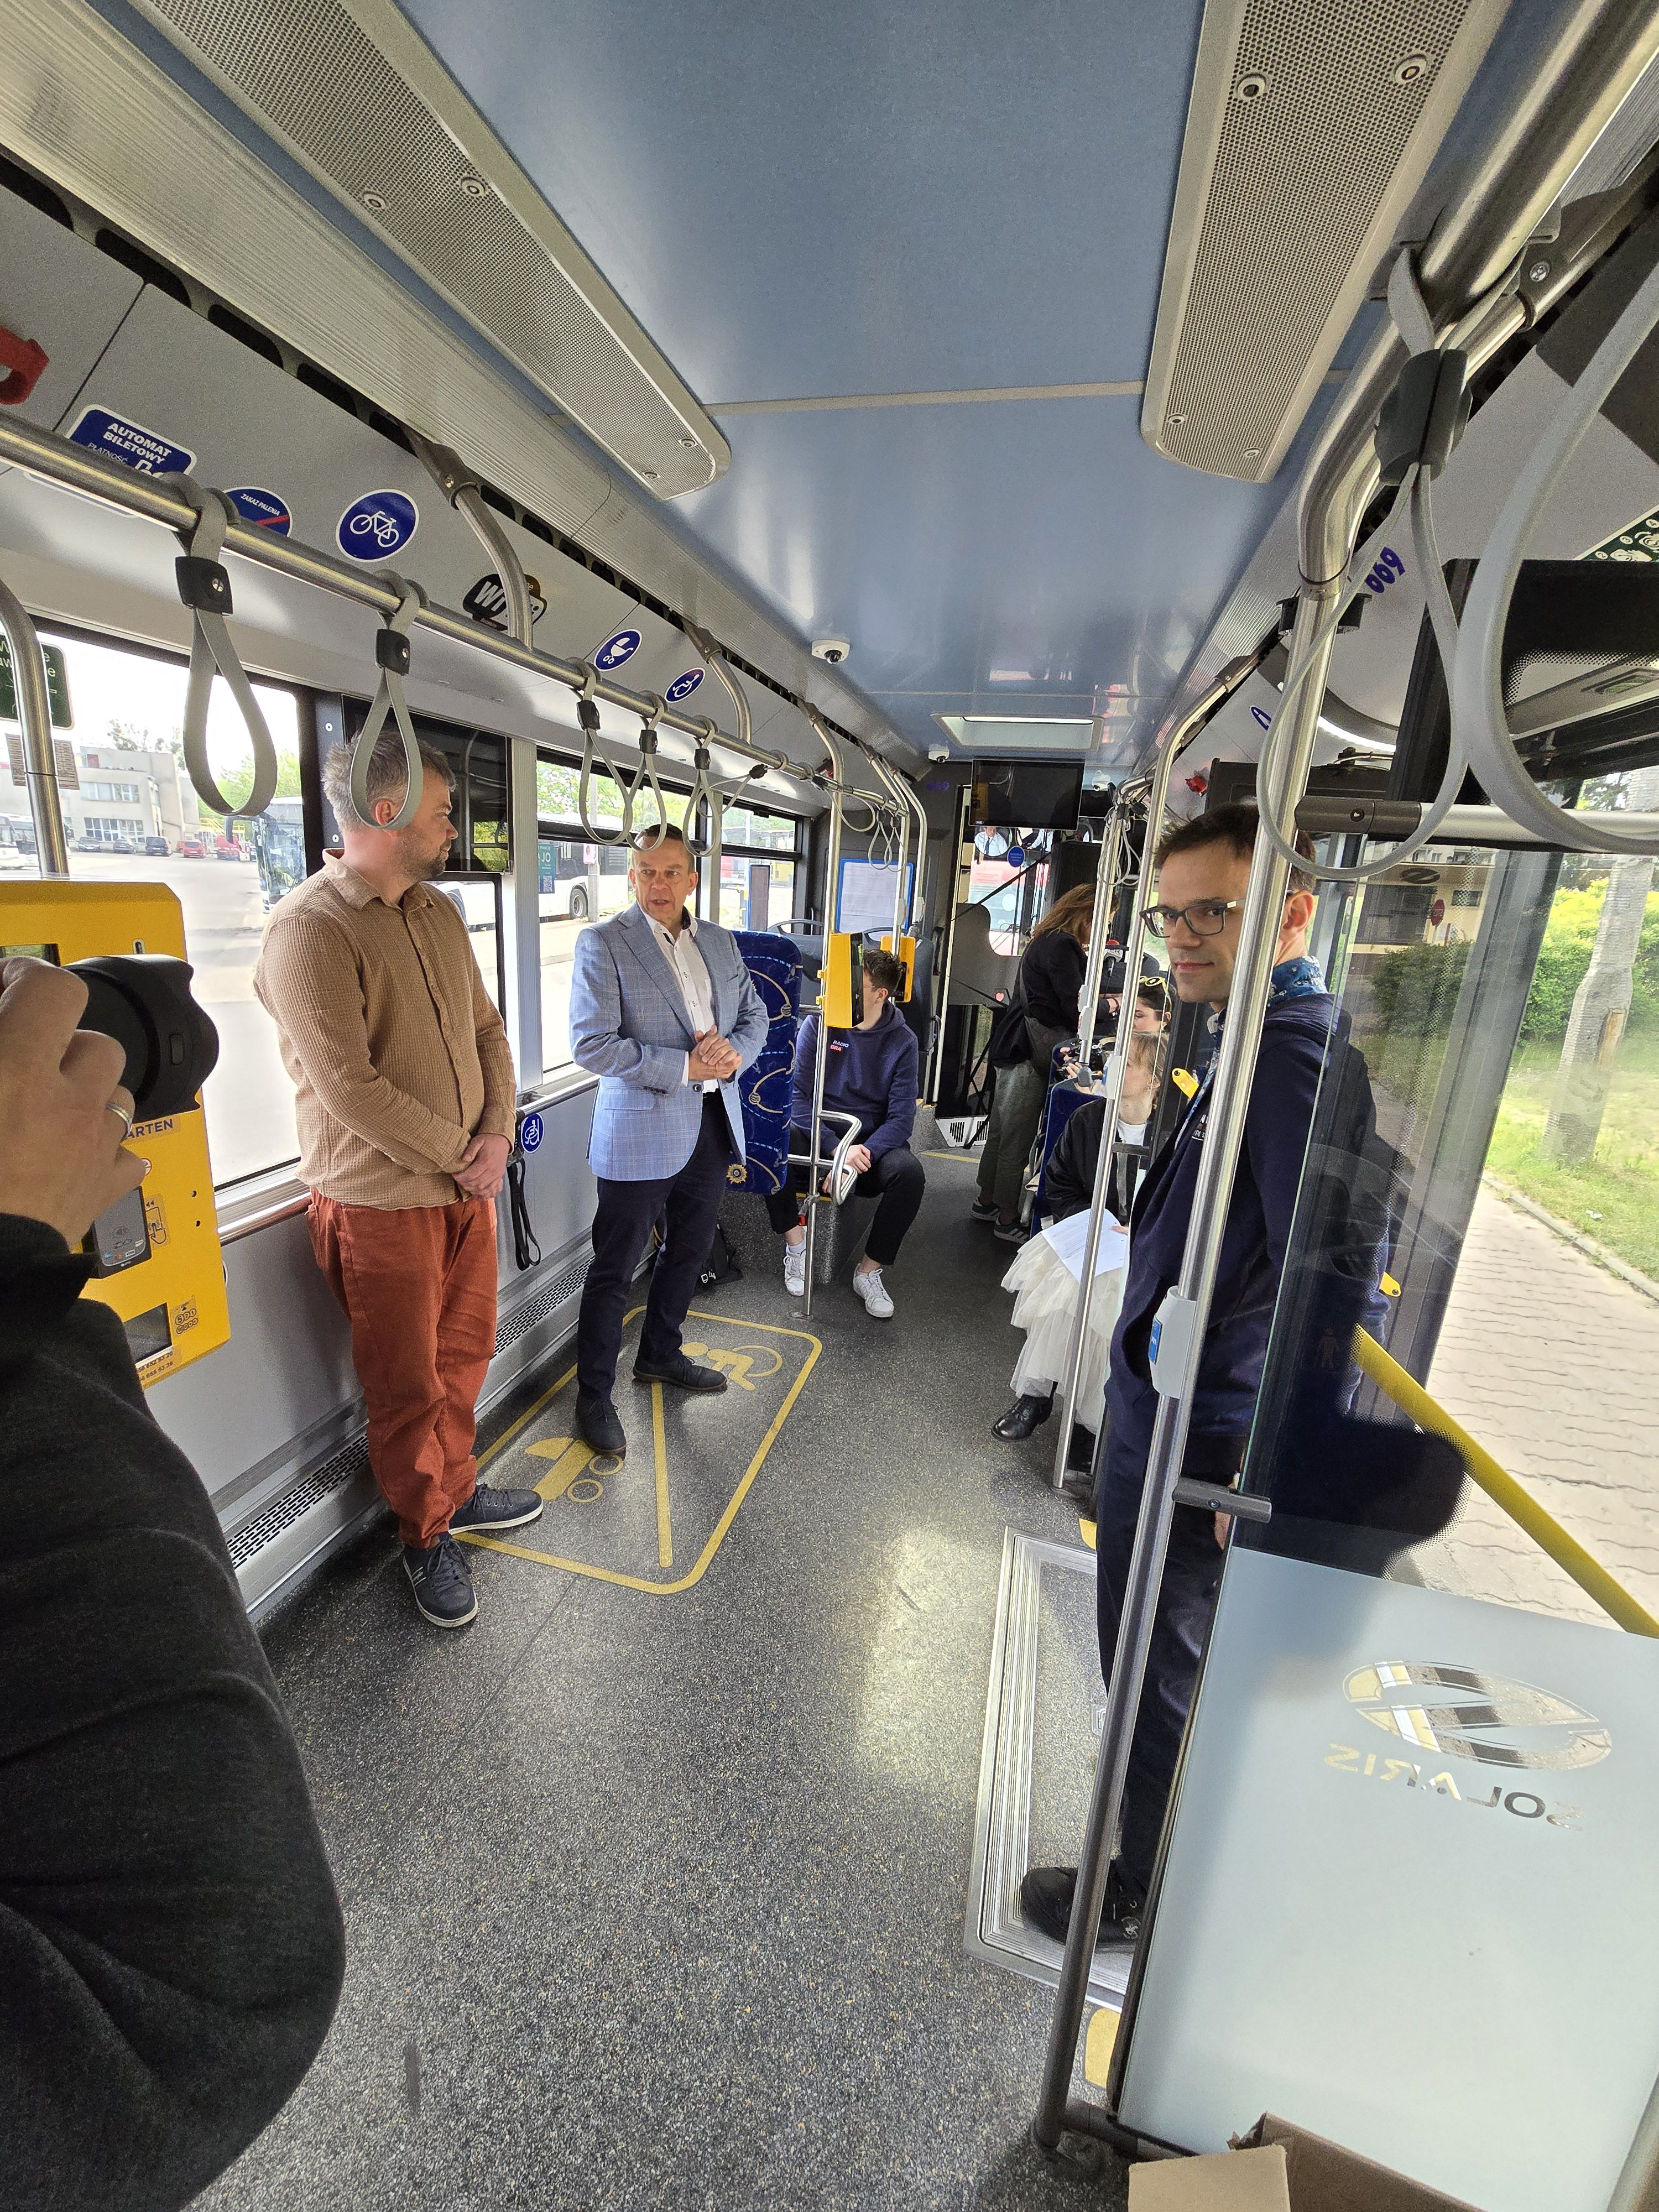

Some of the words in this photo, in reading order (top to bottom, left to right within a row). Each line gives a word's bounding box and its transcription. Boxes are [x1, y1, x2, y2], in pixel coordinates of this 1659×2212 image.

[103, 431, 165, 465] BILETOWY
[107, 422, 172, 457] AUTOMAT
[241, 493, 260, 506] ZAKAZ
[127, 1119, 173, 1138] ARTEN
